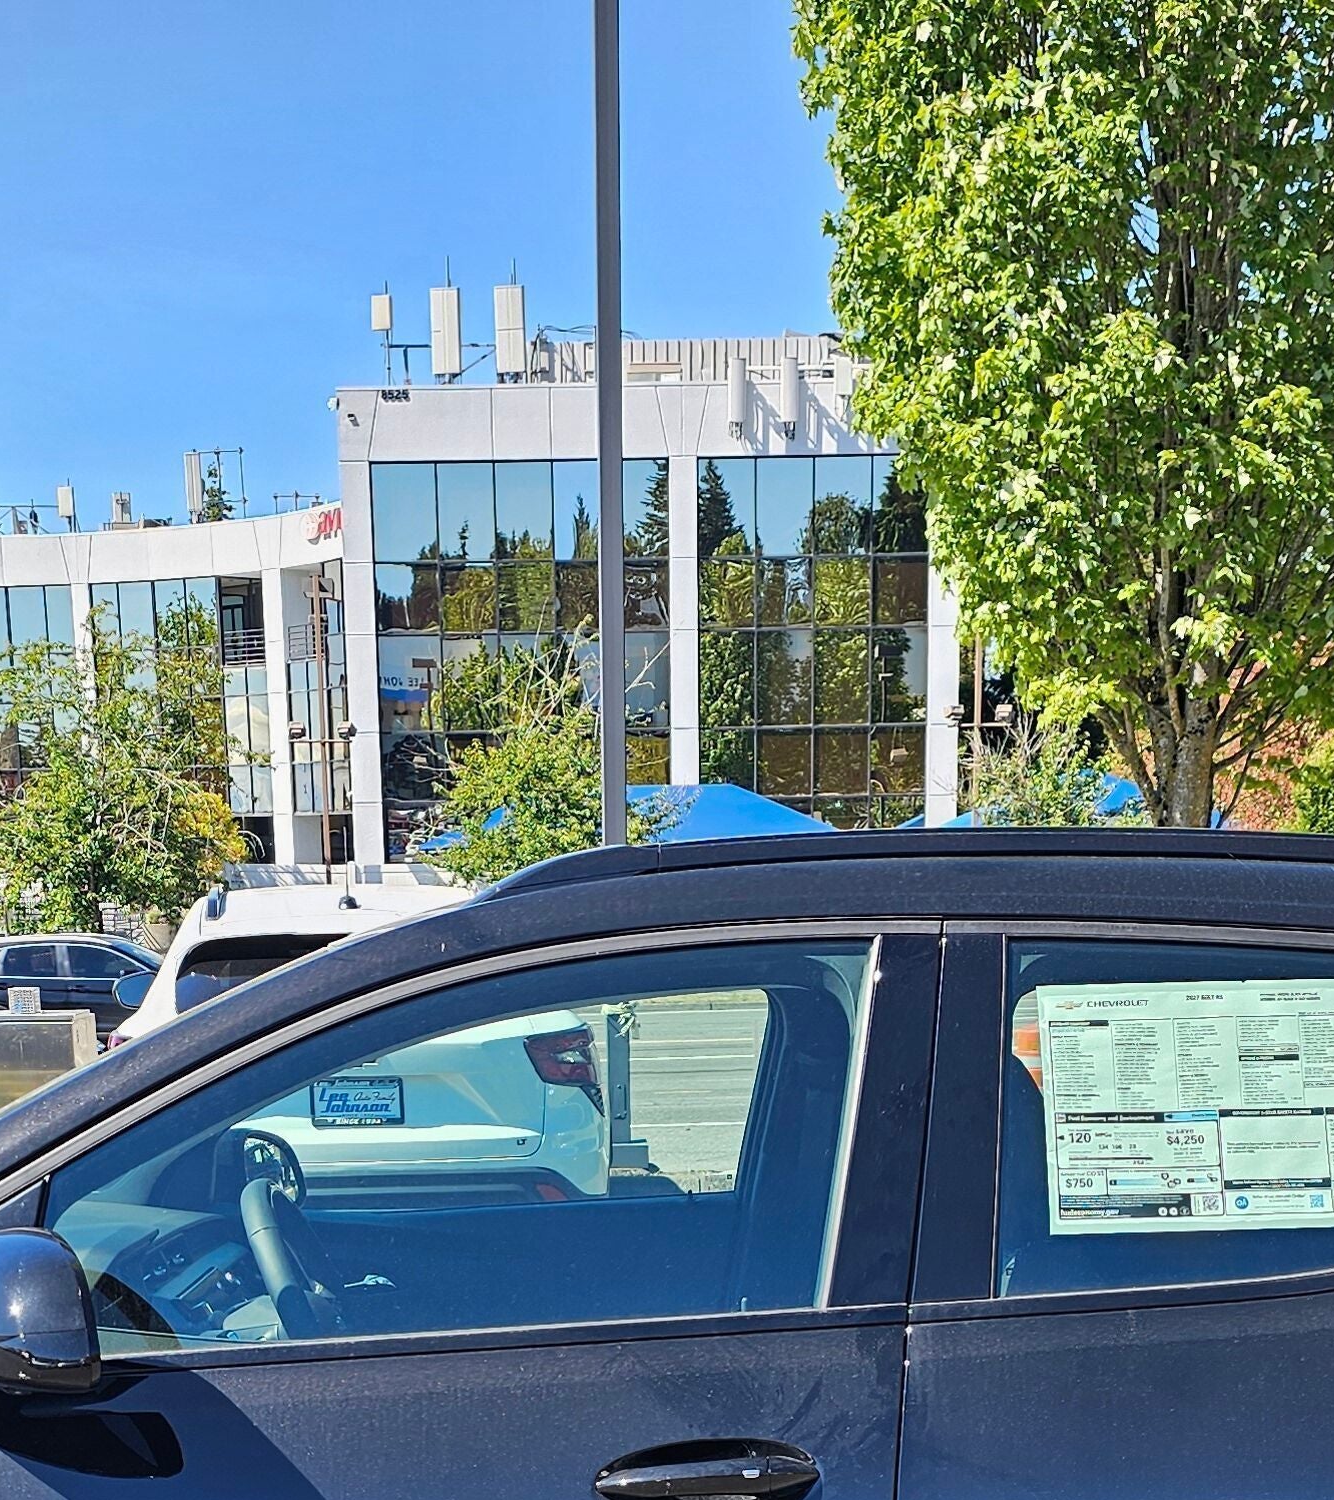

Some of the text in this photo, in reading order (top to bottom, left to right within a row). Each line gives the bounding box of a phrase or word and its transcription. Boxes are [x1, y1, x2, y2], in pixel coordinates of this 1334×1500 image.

[380, 389, 410, 401] 8525
[1087, 999, 1149, 1008] CHEVROLET
[319, 1088, 351, 1102] Lee
[320, 1100, 391, 1113] Johnson
[517, 1138, 527, 1146] LT
[1069, 1132, 1091, 1144] 120
[1167, 1134, 1205, 1146] $4,250
[1065, 1178, 1093, 1188] $750
